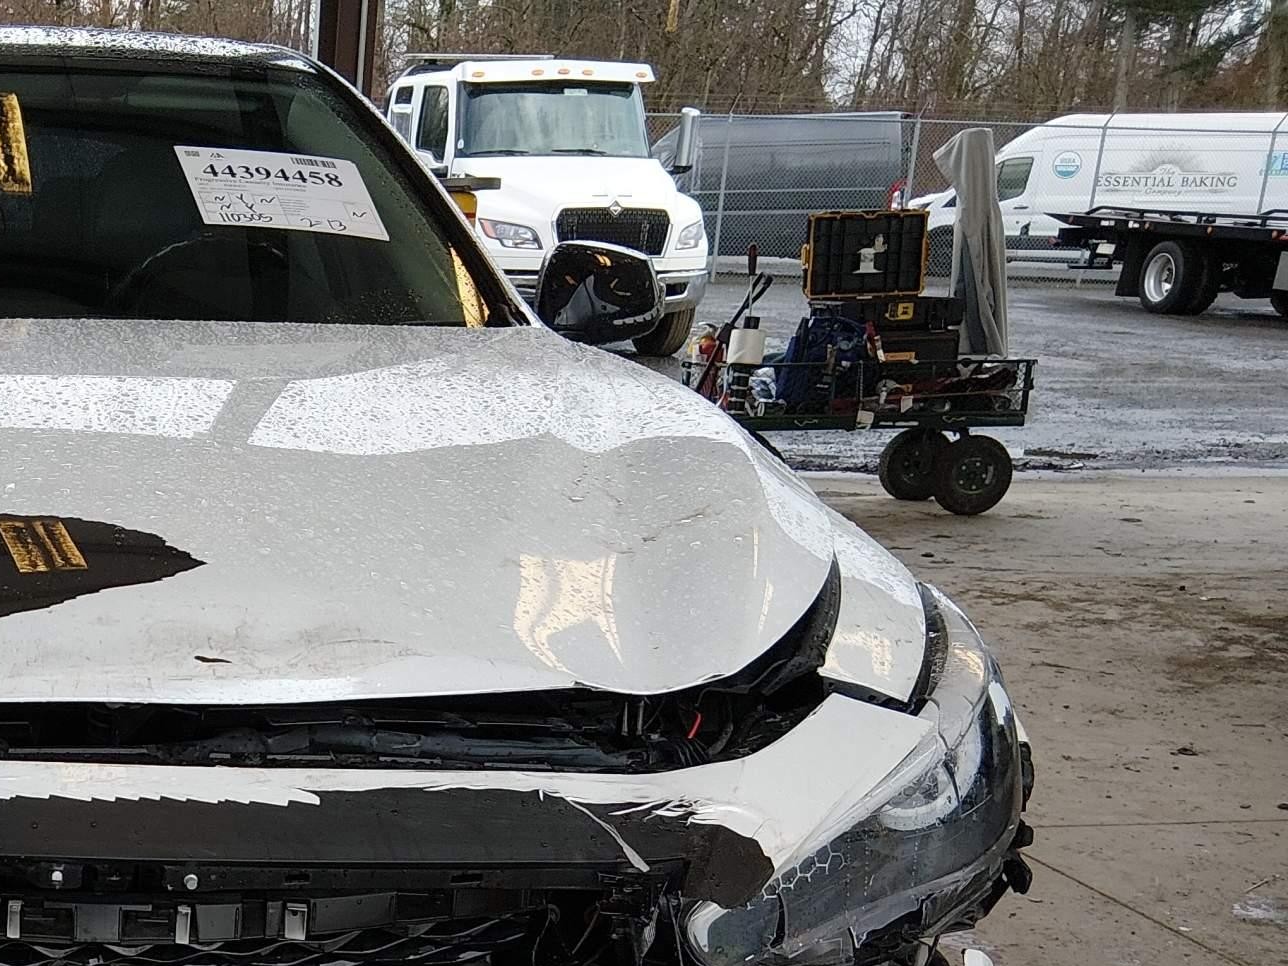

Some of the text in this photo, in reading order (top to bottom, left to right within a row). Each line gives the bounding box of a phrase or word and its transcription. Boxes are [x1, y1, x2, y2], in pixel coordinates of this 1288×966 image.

[202, 163, 344, 188] 44394458
[1096, 176, 1238, 188] ESSENTIAL BAKING
